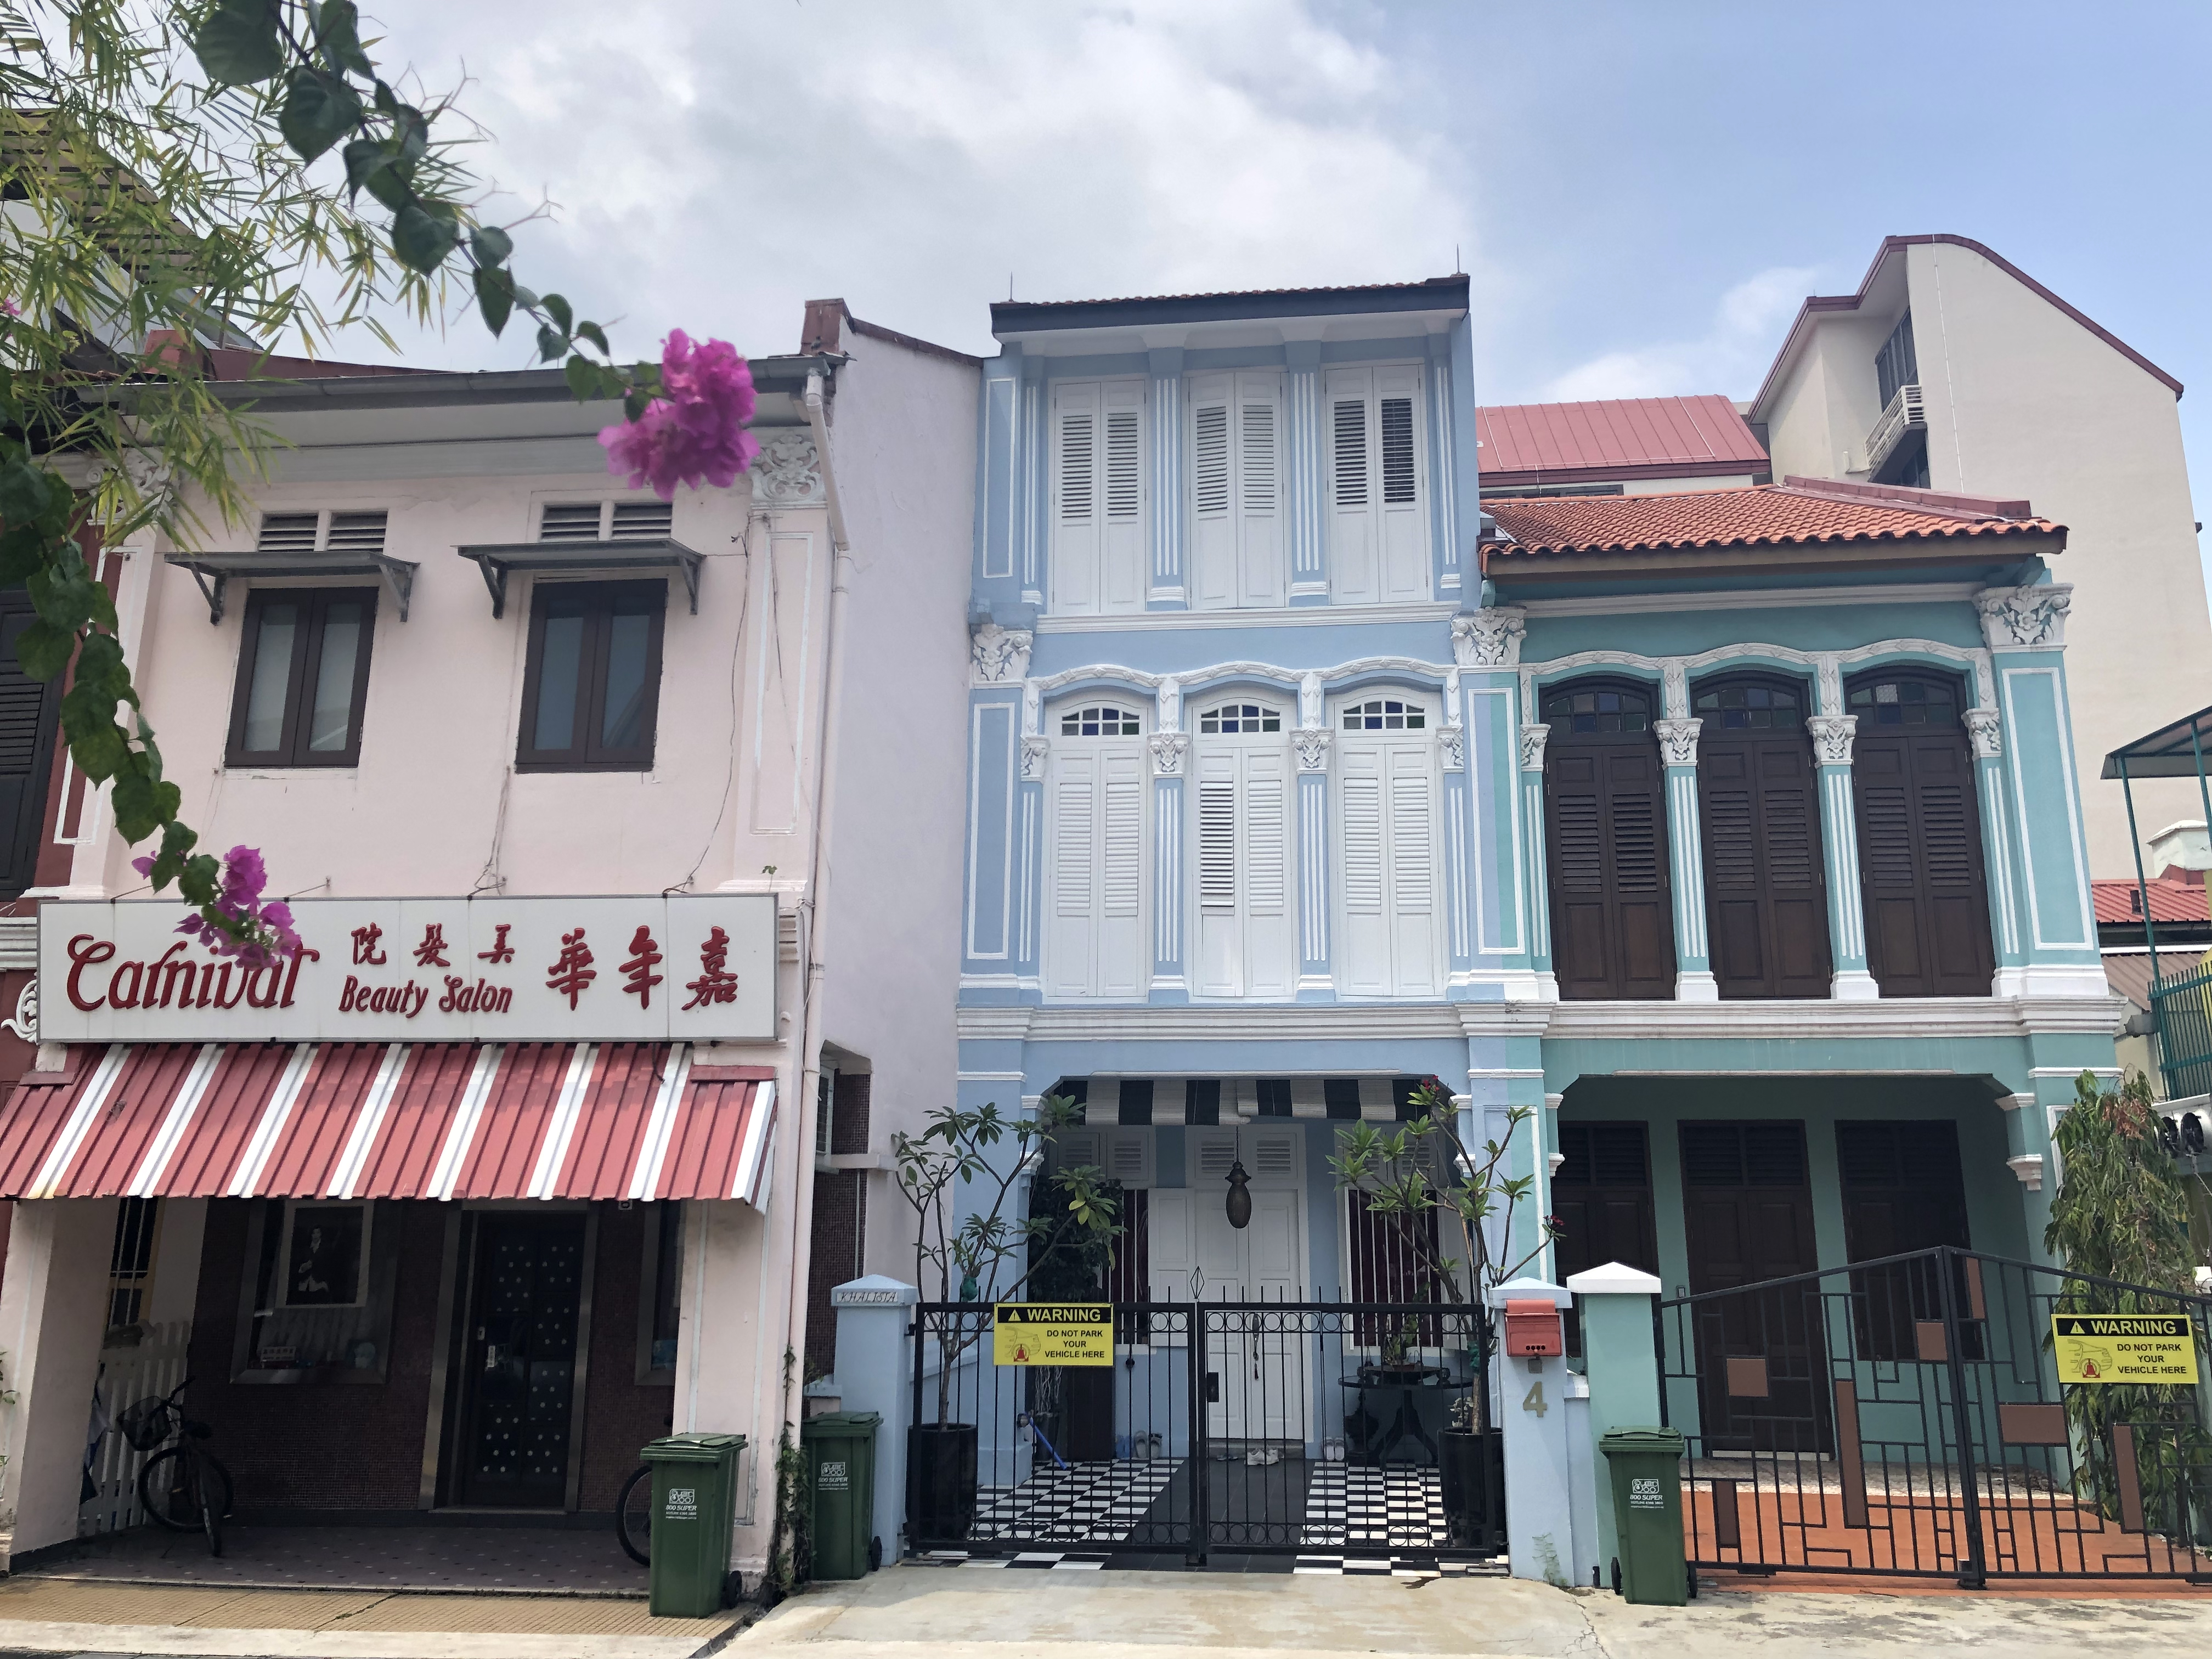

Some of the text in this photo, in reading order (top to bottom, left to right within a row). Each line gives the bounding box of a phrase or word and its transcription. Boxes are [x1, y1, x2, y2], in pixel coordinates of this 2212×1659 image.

[66, 934, 320, 1011] Carnival
[338, 974, 514, 1019] Beauty Salon
[840, 1291, 897, 1303] KHALISTA
[1027, 1308, 1101, 1322] WARNING
[1047, 1329, 1103, 1338] DO NOT PARK
[2090, 1321, 2177, 1334] WARNING
[1045, 1350, 1105, 1358] VEHICLE HERE
[2134, 1344, 2153, 1352] NOT
[2155, 1344, 2182, 1352] PARK
[1522, 1381, 1548, 1418] 4
